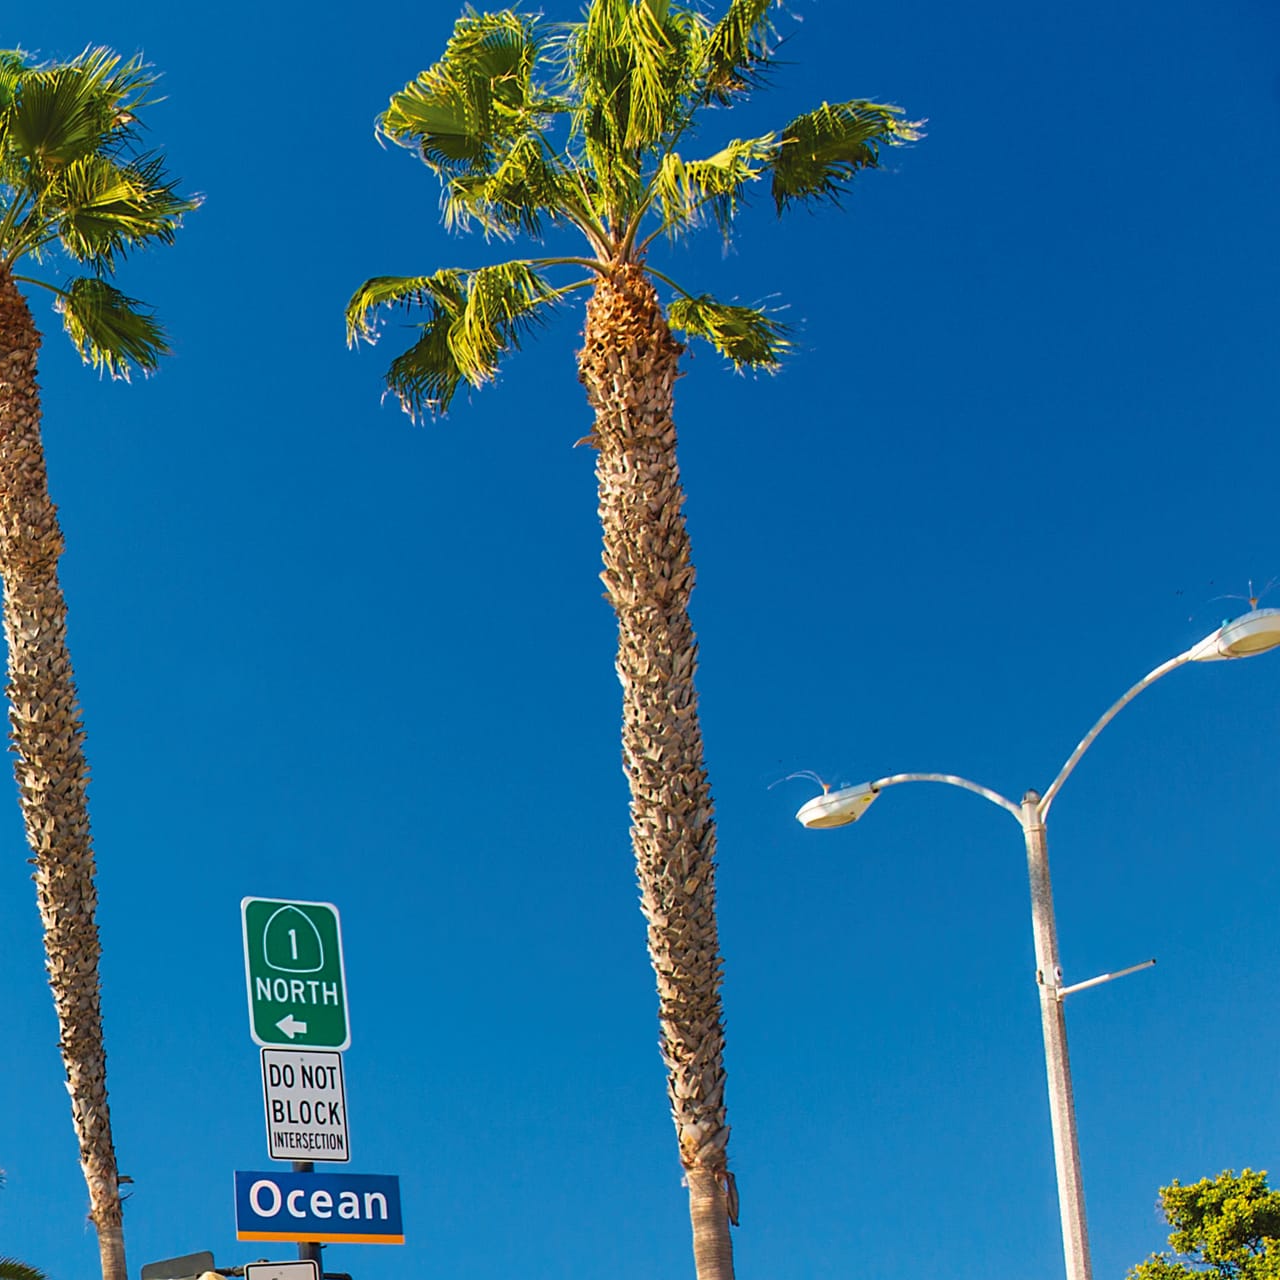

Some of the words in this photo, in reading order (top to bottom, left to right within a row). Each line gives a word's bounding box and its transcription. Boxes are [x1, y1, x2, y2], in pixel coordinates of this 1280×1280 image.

[288, 929, 299, 961] 1
[256, 977, 339, 1006] NORTH
[269, 1064, 295, 1089] DO
[302, 1065, 337, 1090] NOT
[273, 1100, 341, 1126] BLOCK
[273, 1131, 344, 1151] INTERSECTION
[249, 1179, 389, 1221] Ocean
